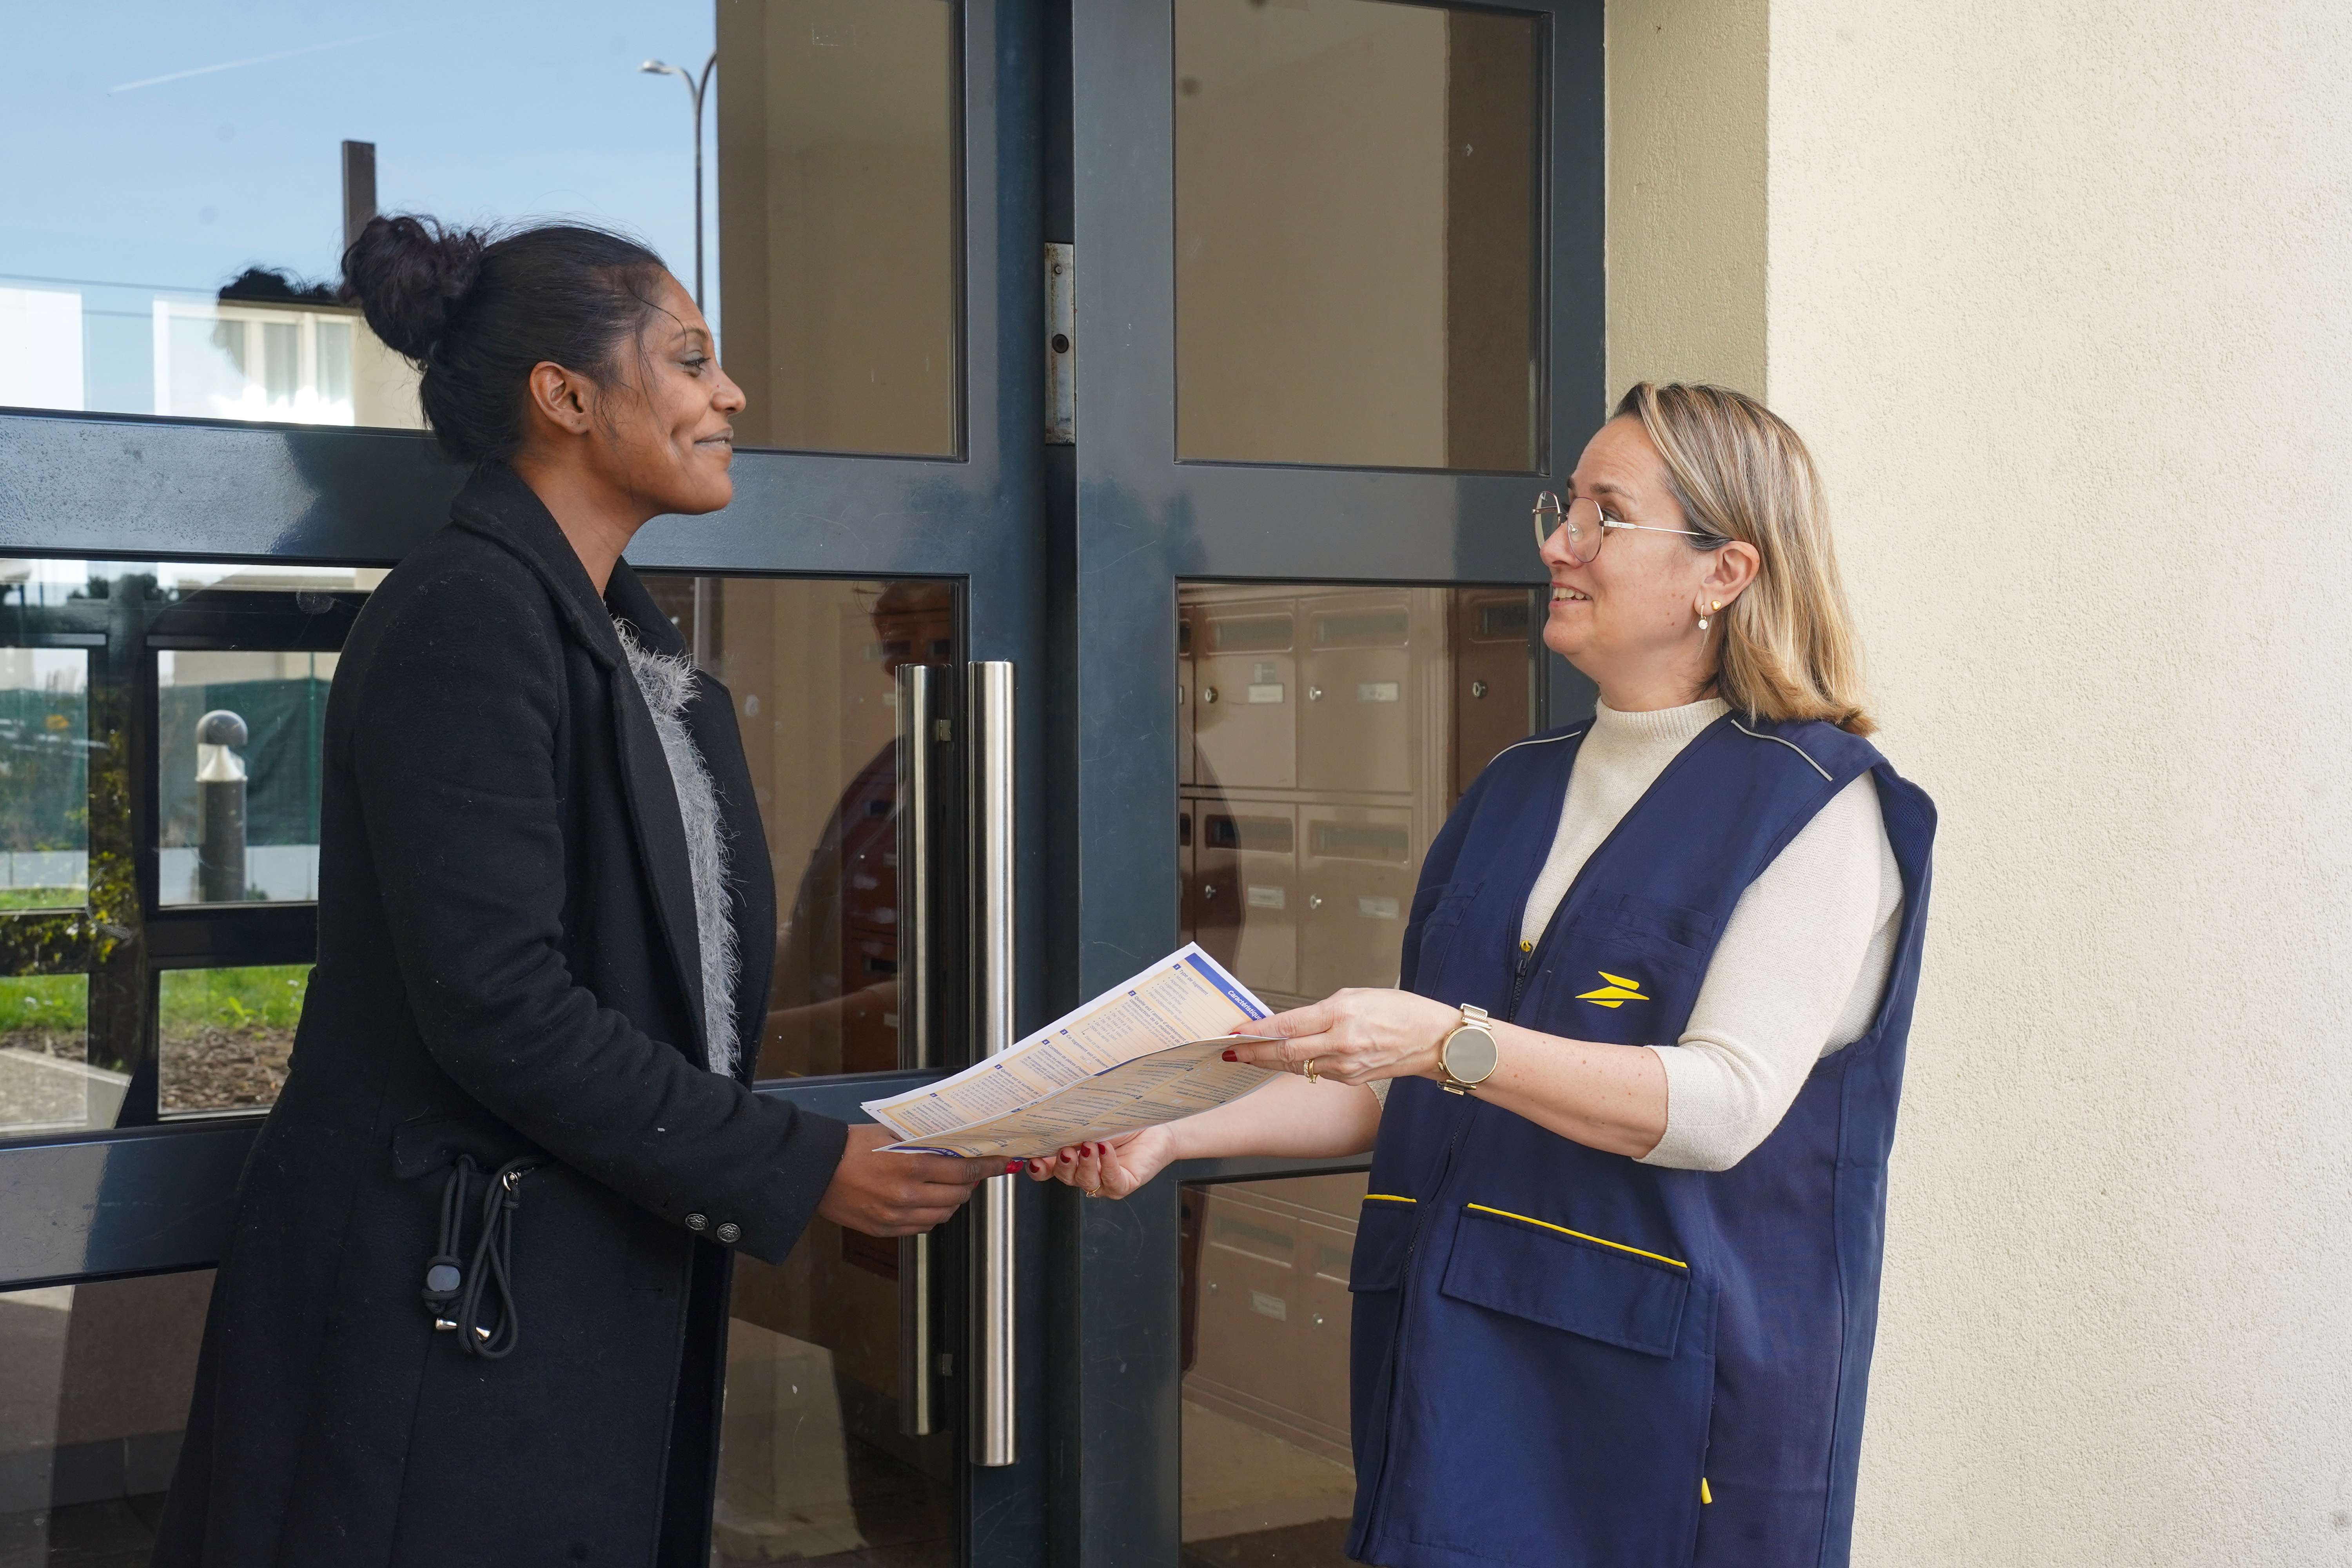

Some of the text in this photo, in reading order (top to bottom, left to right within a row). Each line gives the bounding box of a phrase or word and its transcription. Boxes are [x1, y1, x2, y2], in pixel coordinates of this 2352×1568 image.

[1170, 979, 1189, 995] Appartement
[1176, 975, 1187, 985] Maison
[1179, 969, 1188, 978] Type
[1192, 981, 1208, 995] logement
[1159, 985, 1182, 1005] Chambre d'hôtel
[1164, 982, 1186, 1000] Logement-foyer
[1120, 1004, 1130, 1012] l'année
[1153, 989, 1168, 1002] Habitation
[1171, 1004, 1182, 1014] fortune
[1156, 999, 1174, 1015] indépendante
[1117, 1010, 1127, 1018] Avant
[1129, 999, 1150, 1017] construction
[1158, 1024, 1171, 1035] maison
[1131, 1008, 1144, 1019] différentes
[1134, 996, 1146, 1006] Quelle
[1151, 1011, 1163, 1022] l'année
[1163, 1022, 1186, 1041] d'achèvement
[1048, 1044, 1062, 1056] Combien
[1071, 1039, 1087, 1052] logement
[1021, 1083, 1034, 1092] surface
